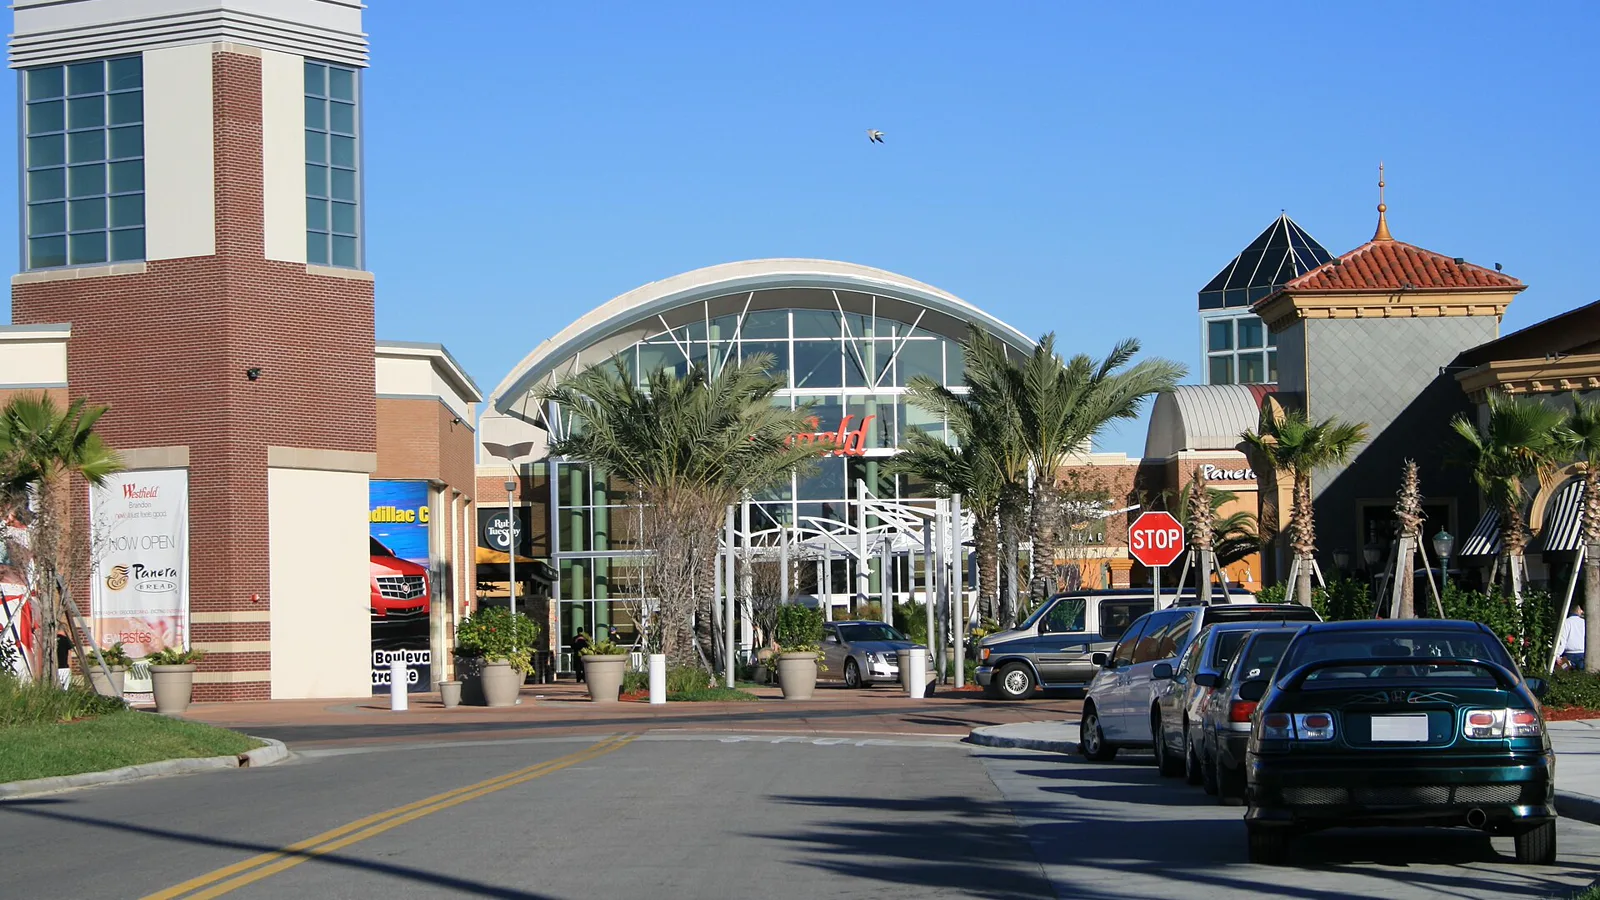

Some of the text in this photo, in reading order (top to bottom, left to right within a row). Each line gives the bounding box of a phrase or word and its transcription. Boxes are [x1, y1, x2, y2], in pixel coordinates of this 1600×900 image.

[122, 483, 159, 499] Westfield
[128, 501, 152, 509] Brandon
[368, 506, 415, 523] dillac
[108, 534, 175, 551] NOW OPEN
[1133, 528, 1180, 550] STOP
[132, 563, 177, 580] Panera
[119, 630, 152, 645] tastes
[371, 670, 418, 684] trae
